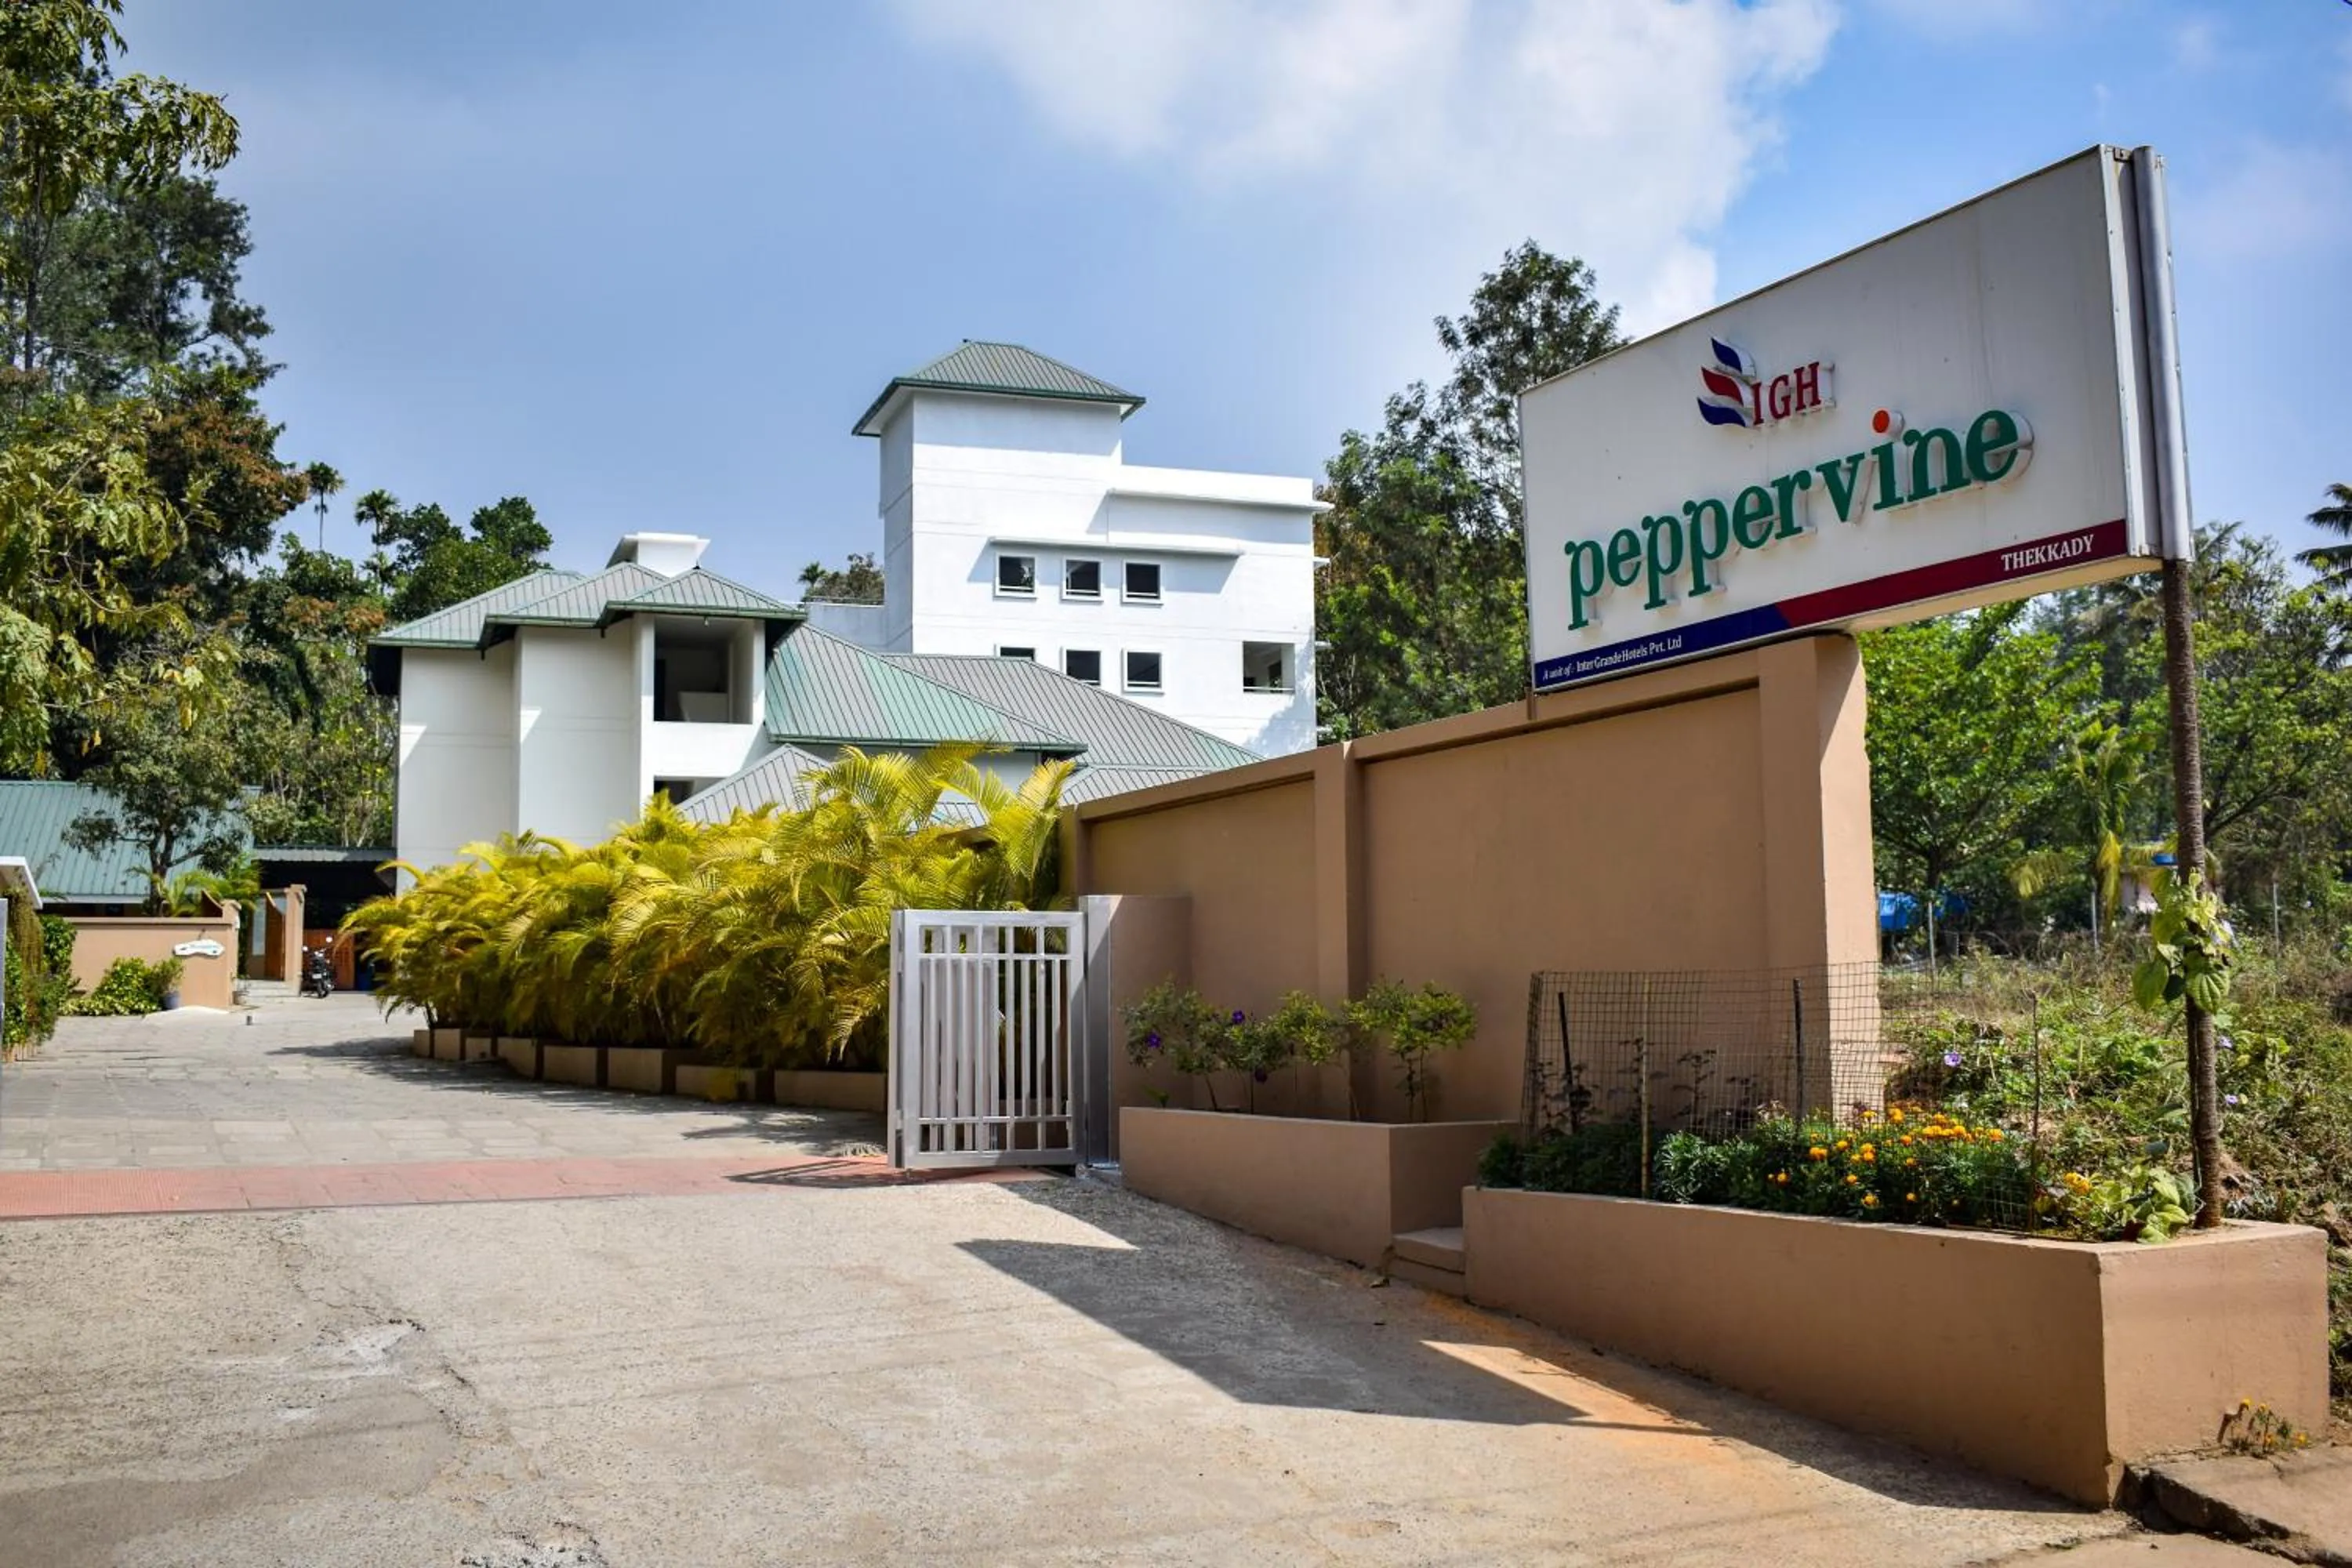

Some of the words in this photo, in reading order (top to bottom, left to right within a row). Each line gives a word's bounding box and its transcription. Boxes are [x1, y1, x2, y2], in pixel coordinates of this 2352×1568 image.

[1751, 361, 1822, 426] IGH
[1563, 408, 2020, 631] peppervine
[2000, 533, 2095, 572] THEKKADY
[1542, 669, 1548, 681] A
[1668, 634, 1682, 651] Ltd
